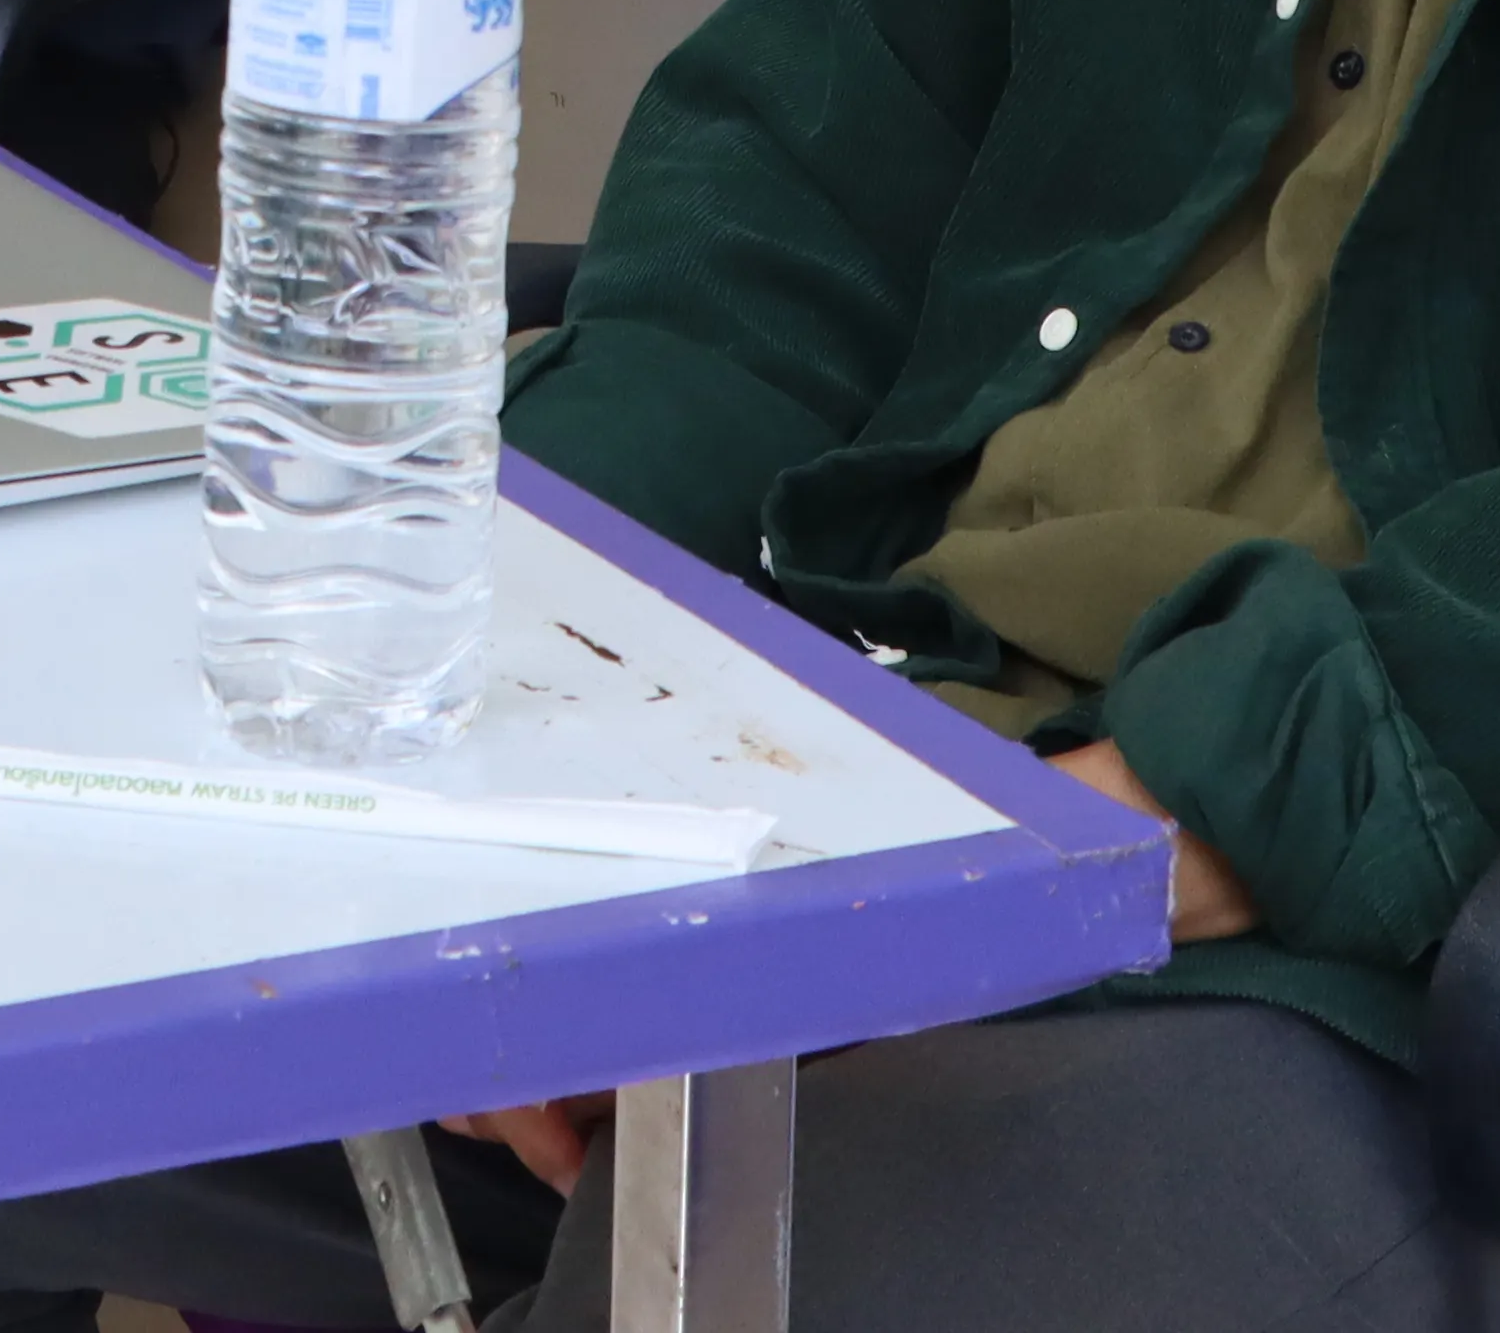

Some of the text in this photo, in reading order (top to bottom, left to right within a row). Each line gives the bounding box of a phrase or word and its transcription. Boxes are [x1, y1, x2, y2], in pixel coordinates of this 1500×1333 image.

[191, 782, 266, 804] STRAW
[271, 789, 298, 807] PE
[304, 791, 377, 813] GREEN
